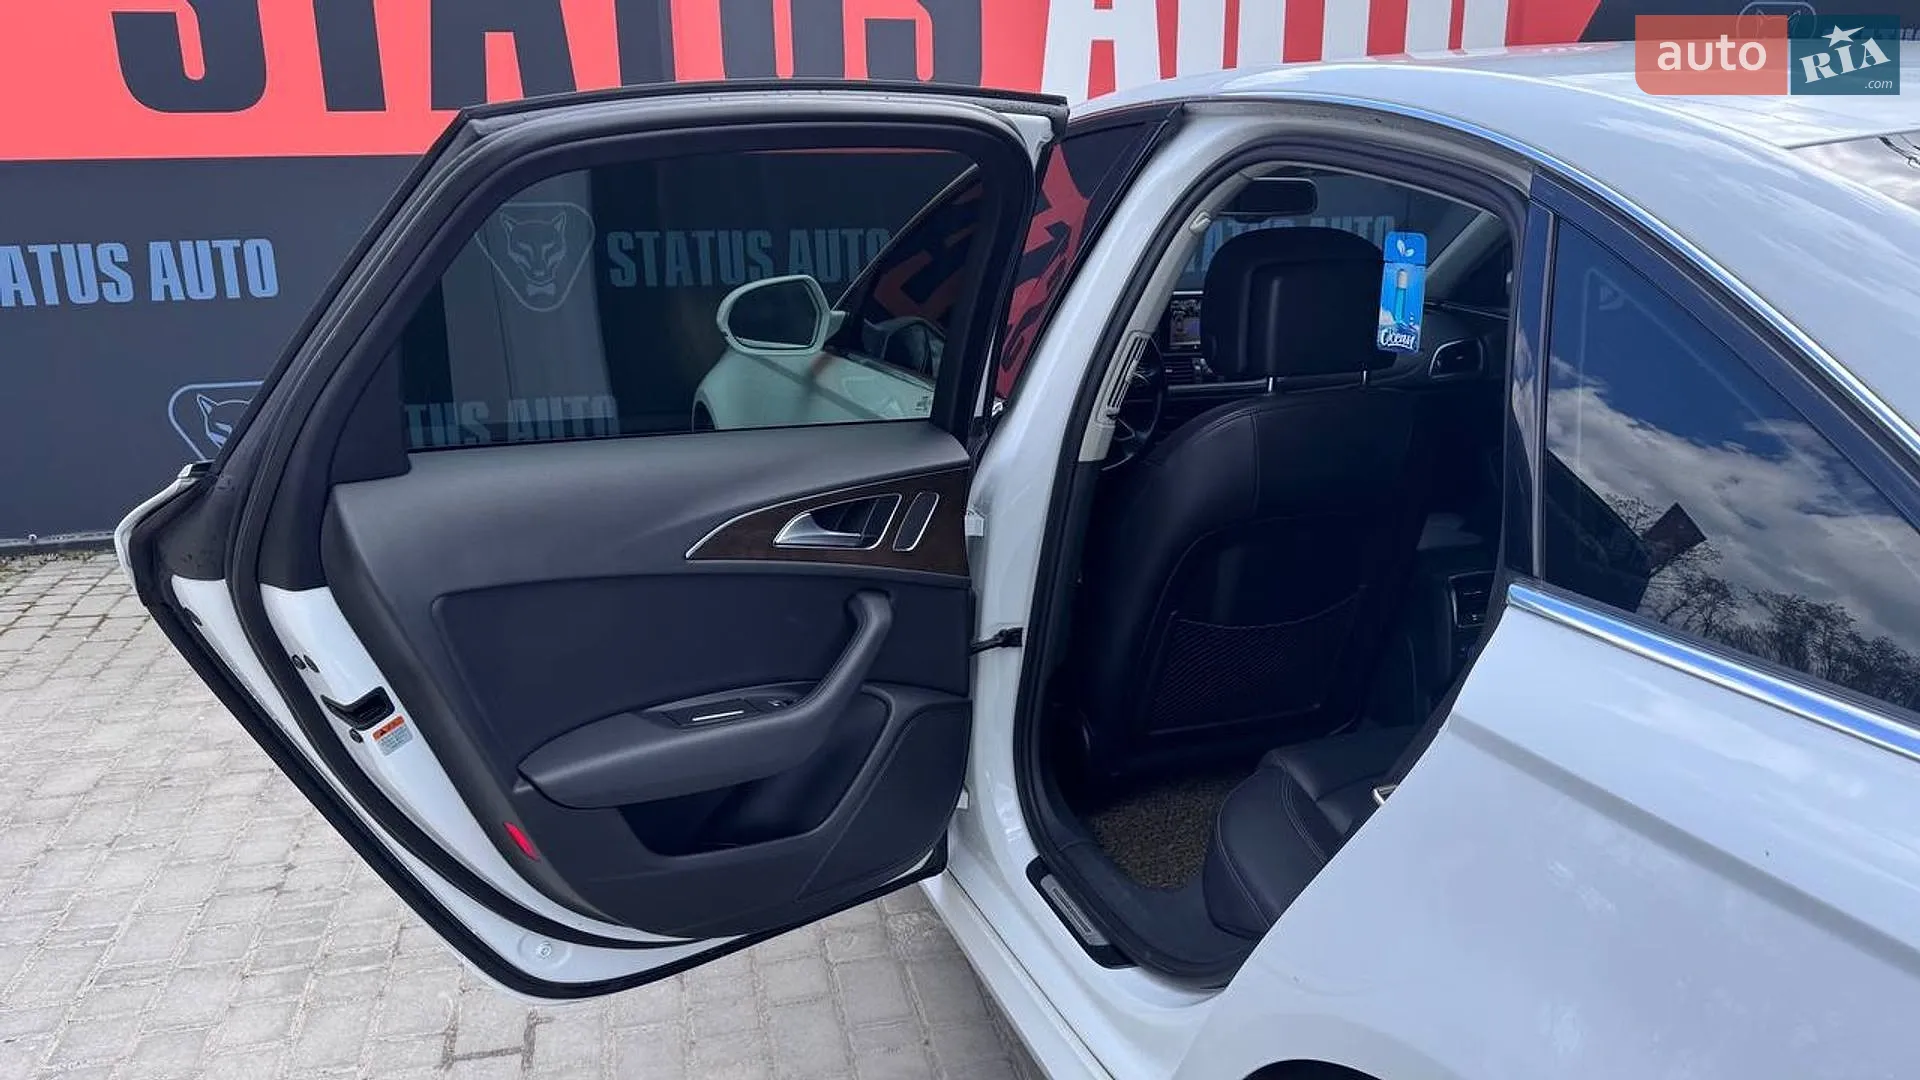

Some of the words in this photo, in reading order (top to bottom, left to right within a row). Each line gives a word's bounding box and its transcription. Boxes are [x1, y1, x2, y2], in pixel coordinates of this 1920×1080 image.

[0, 242, 135, 307] ATUS
[149, 238, 280, 302] AUTO
[606, 228, 775, 289] STATUS
[507, 396, 620, 441] AUTO
